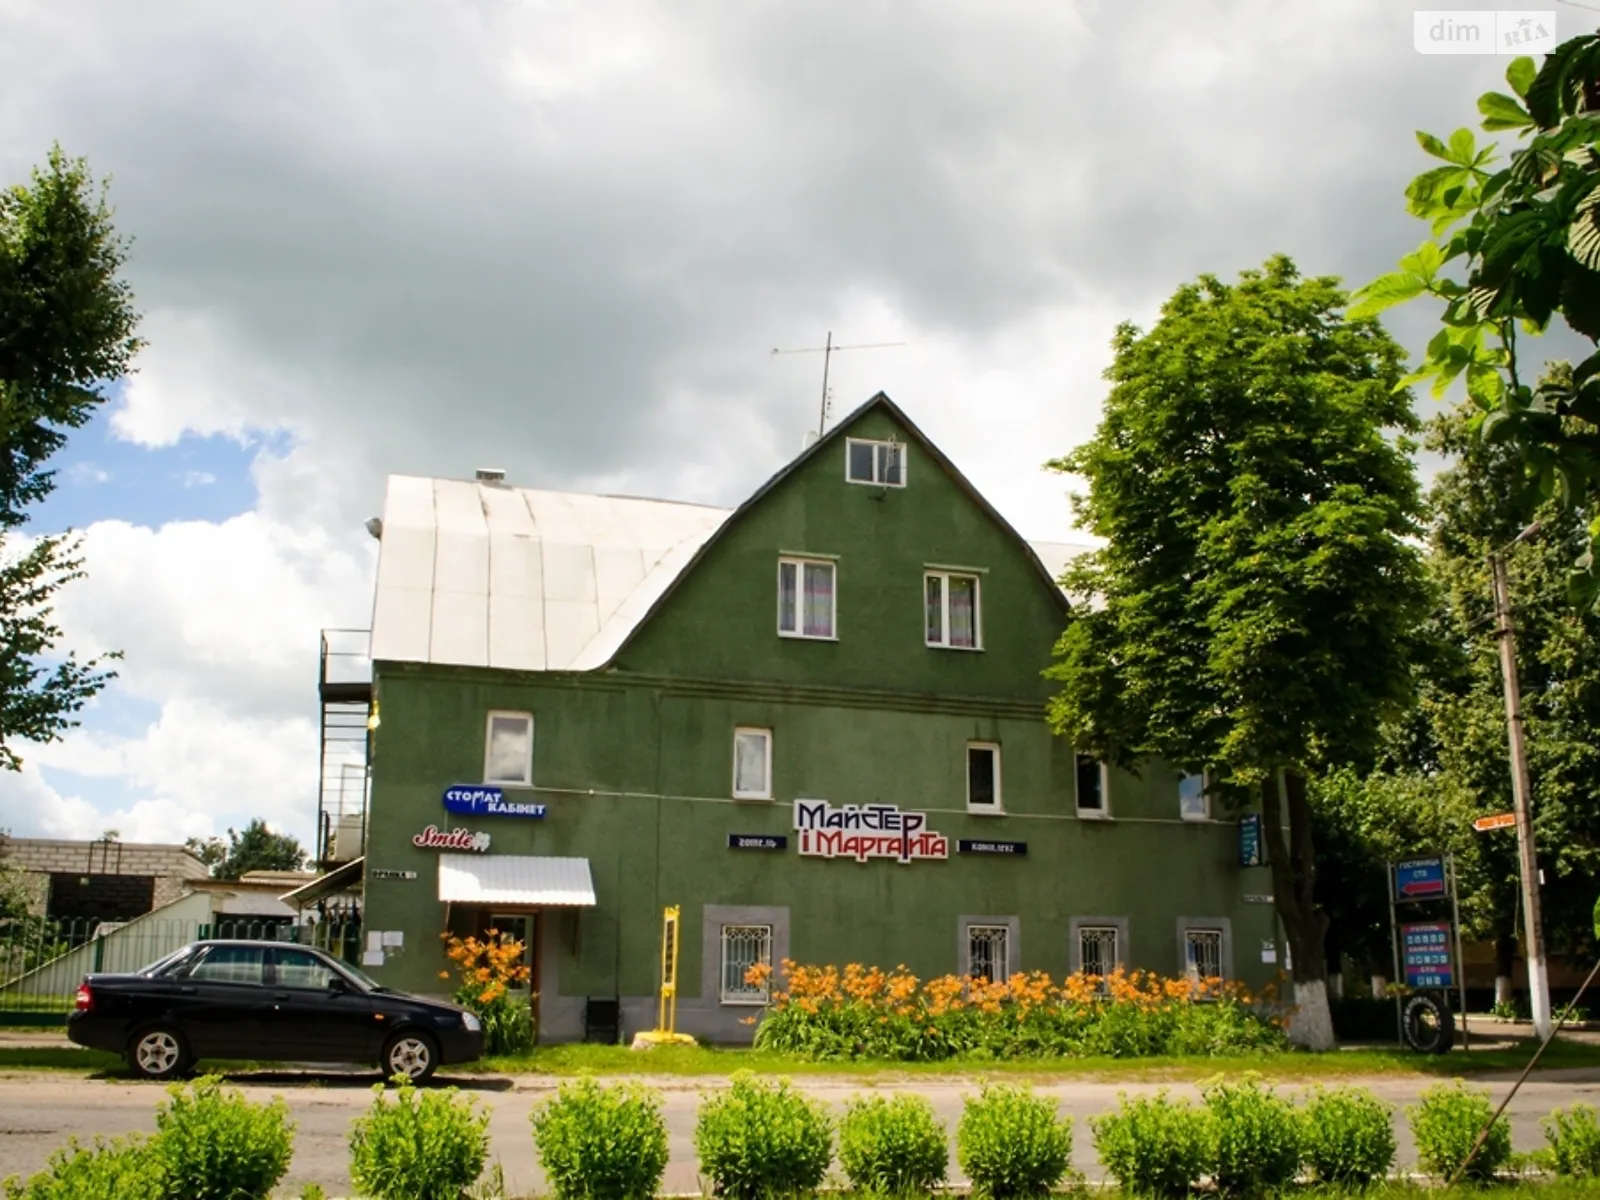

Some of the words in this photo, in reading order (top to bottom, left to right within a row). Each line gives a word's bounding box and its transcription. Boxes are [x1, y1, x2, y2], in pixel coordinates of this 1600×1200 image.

[446, 790, 502, 811] СТОМАТ
[487, 802, 546, 816] КАБІНЕТ
[413, 825, 474, 849] Smile
